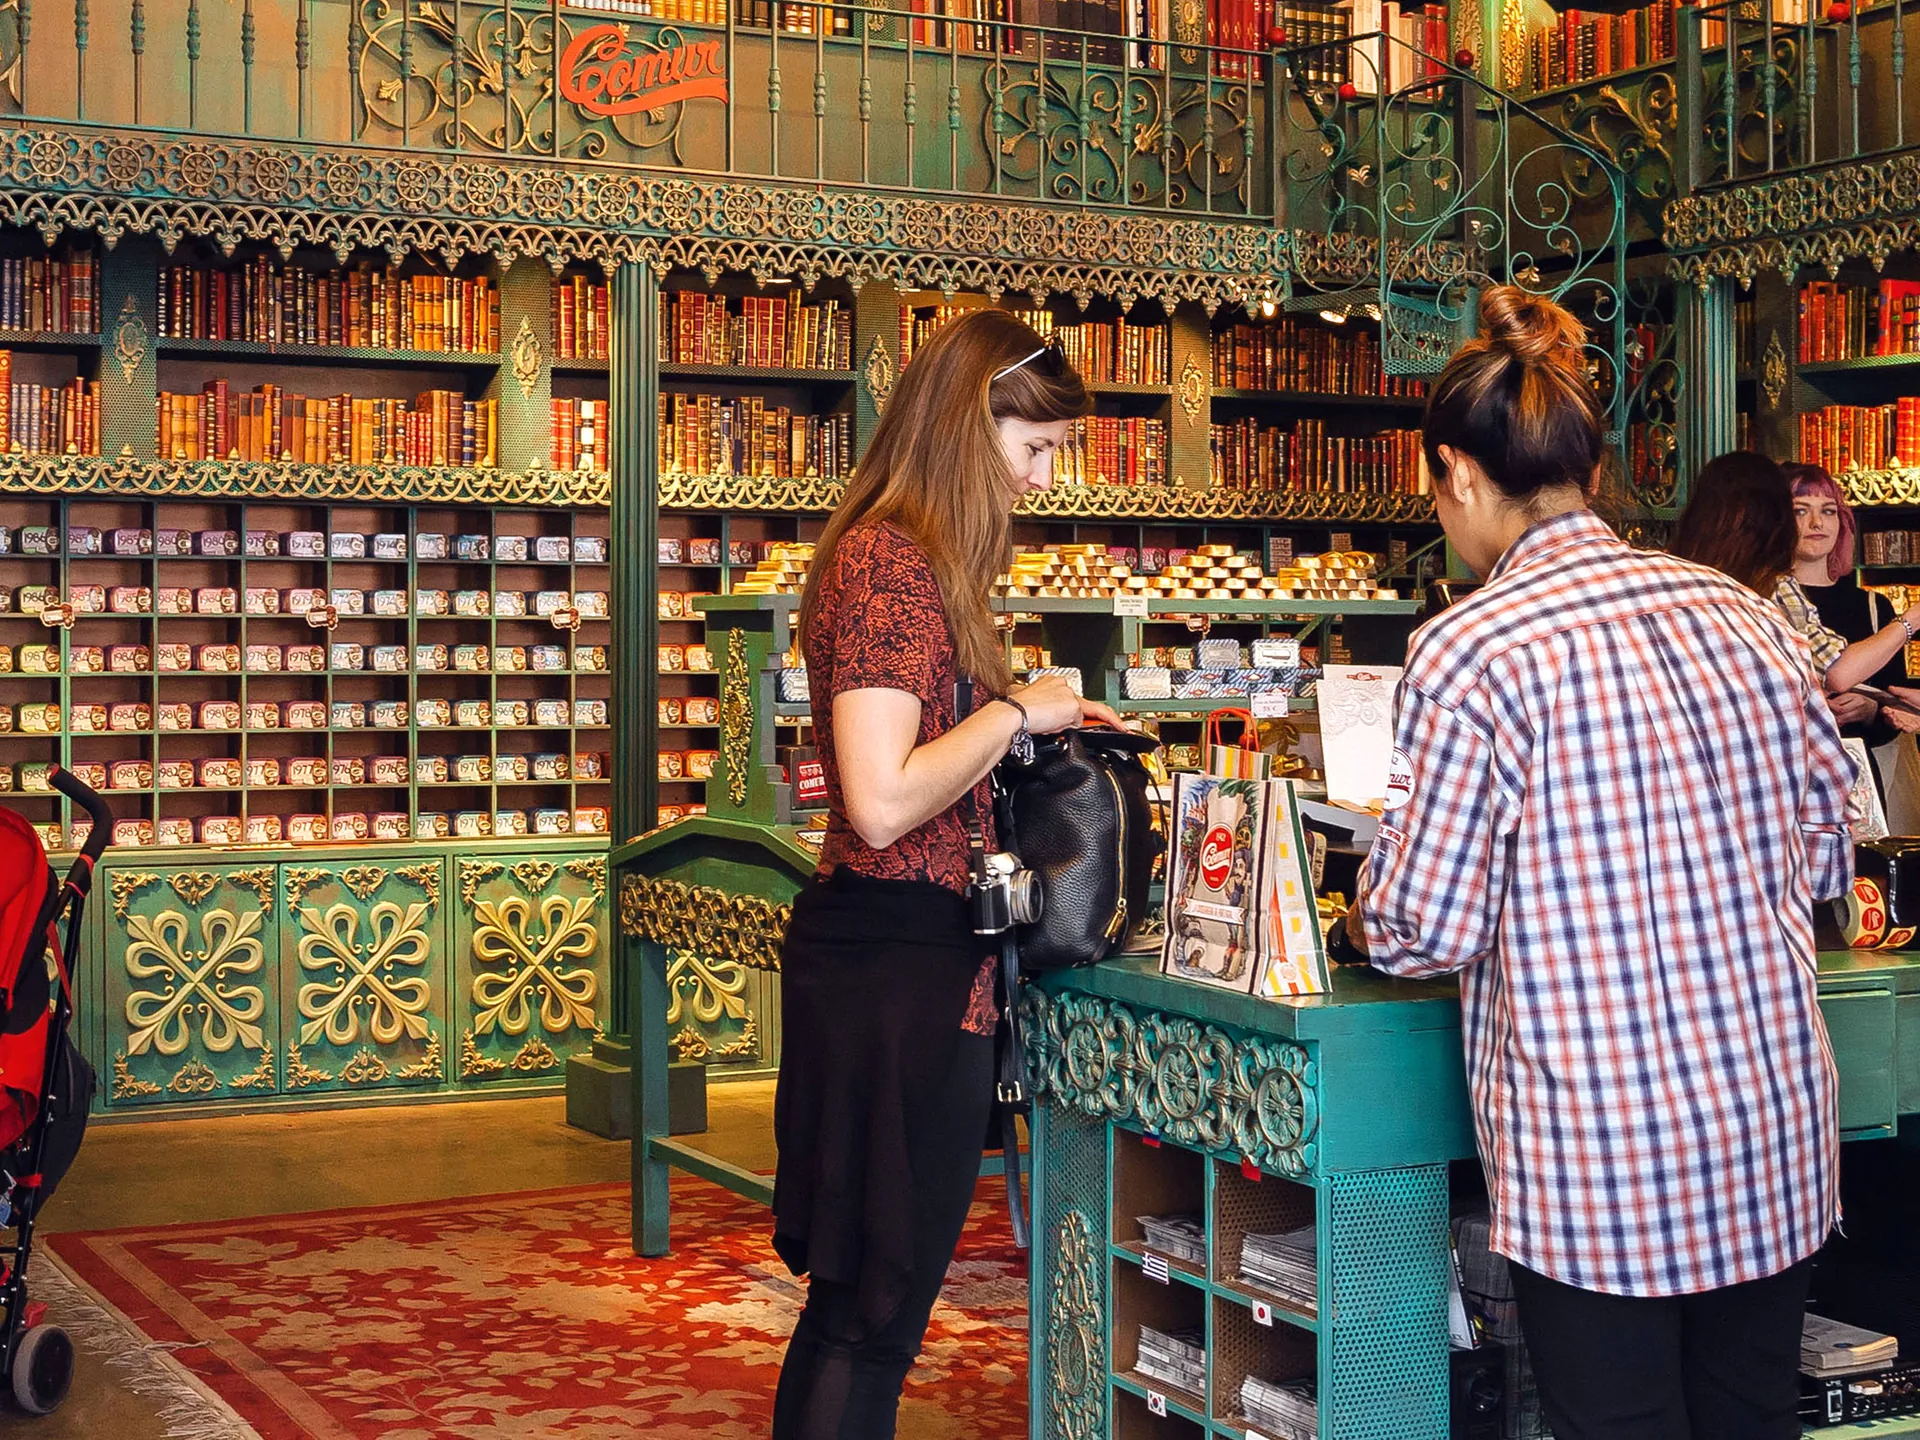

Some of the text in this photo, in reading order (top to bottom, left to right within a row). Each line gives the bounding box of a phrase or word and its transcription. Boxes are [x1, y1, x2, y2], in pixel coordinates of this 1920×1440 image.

[560, 24, 727, 115] Comur
[24, 532, 47, 544] 1986
[23, 592, 45, 603] 1986
[290, 651, 310, 662] 1978
[291, 709, 311, 719] 1978
[377, 764, 396, 774] 1976
